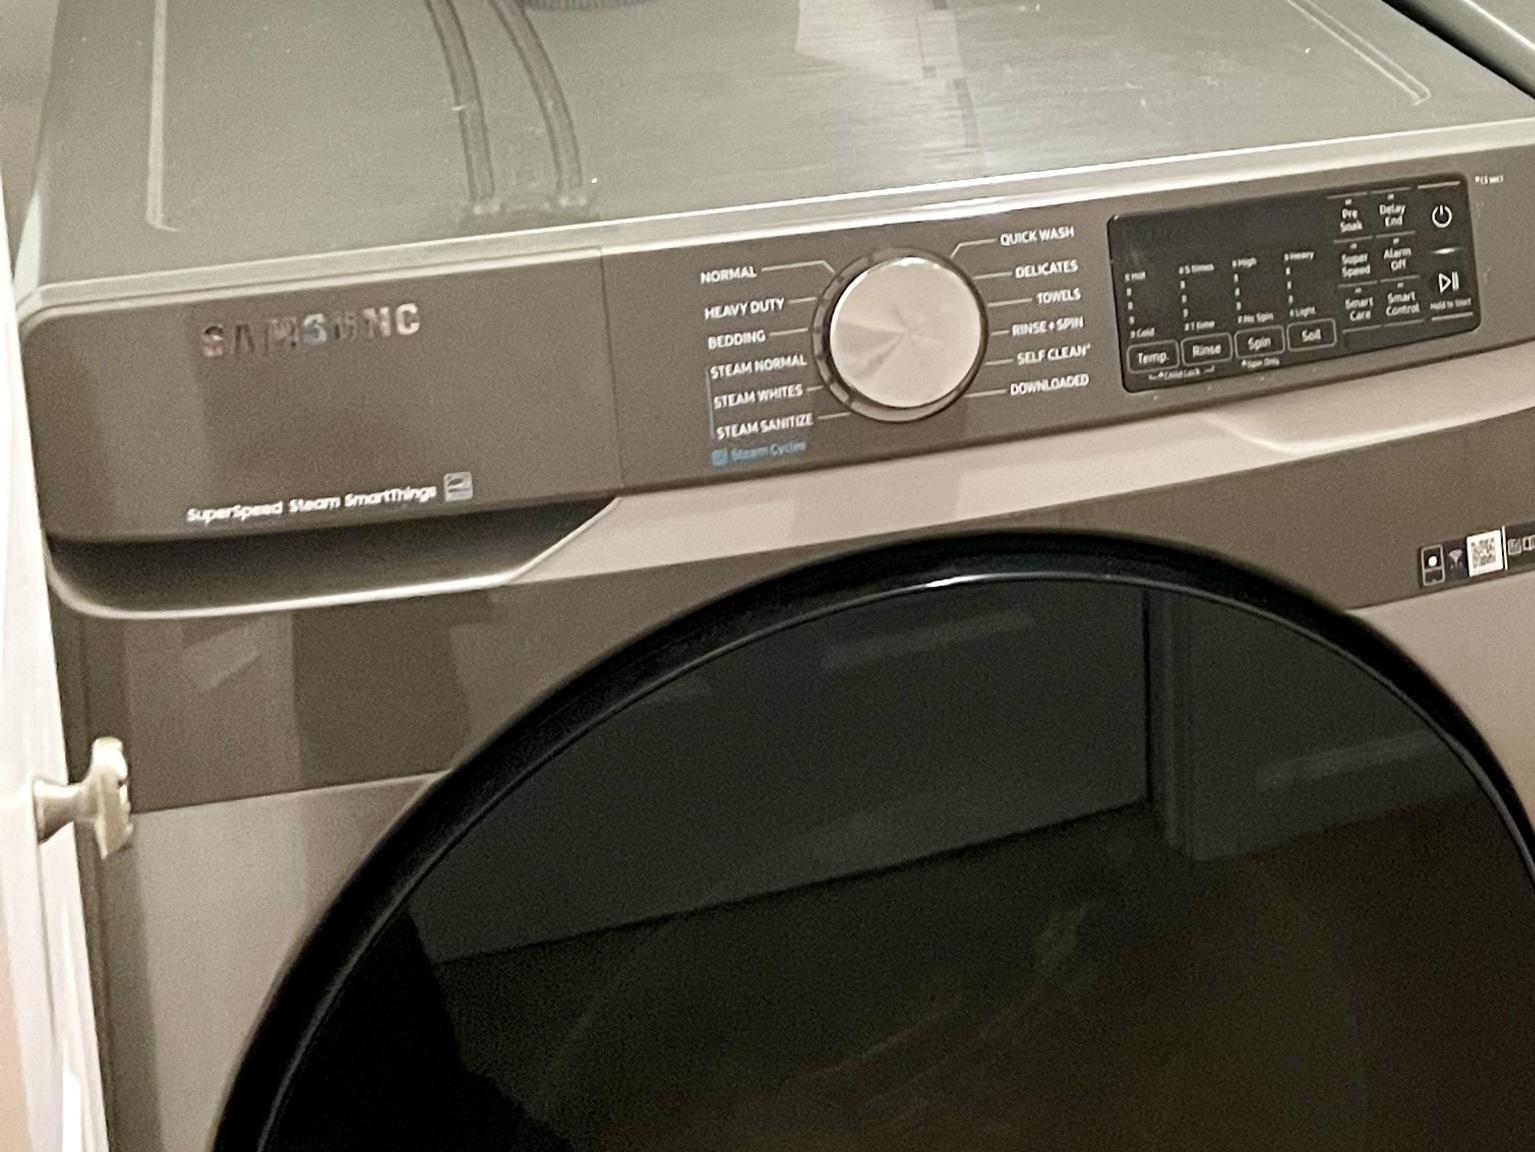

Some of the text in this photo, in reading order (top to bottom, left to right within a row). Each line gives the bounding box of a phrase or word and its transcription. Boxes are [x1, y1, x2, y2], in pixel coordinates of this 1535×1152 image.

[1341, 208, 1358, 219] Pre
[1379, 203, 1406, 215] Delay
[1340, 219, 1363, 233] Soak
[1385, 215, 1403, 228] End
[1000, 225, 1075, 246] QUICK WASH
[1341, 253, 1368, 265] Super
[1384, 247, 1412, 259] Alarm
[1015, 259, 1079, 279] DELICATES
[1341, 264, 1371, 278] Speed
[1390, 258, 1406, 271] Off
[700, 266, 757, 284] NORMAL
[1036, 288, 1082, 305] TOWELS
[1345, 296, 1374, 310] Smart
[1388, 291, 1416, 304] Smart
[704, 297, 785, 320] HEAVY DUTY
[1350, 310, 1371, 321] Care
[1386, 302, 1420, 317] Control
[1012, 320, 1047, 337] RINSE
[1056, 316, 1084, 332] SPIN
[1136, 328, 1155, 338] Cold
[707, 329, 766, 350] BEDDING
[1301, 328, 1321, 342] Soil
[1192, 344, 1221, 357] Rinse
[1248, 337, 1271, 351] Spin
[1017, 349, 1046, 366] SELF
[1138, 352, 1169, 364] Temp.
[710, 354, 808, 380] STEAM NORMAL
[1010, 373, 1090, 396] DOWNLOADED
[713, 383, 803, 409] STEAM WHITES
[716, 413, 814, 440] STEAM SANITIZE
[731, 441, 806, 461] Steam Cycles
[186, 485, 437, 527] SuperSpeed Steam SmartThings
